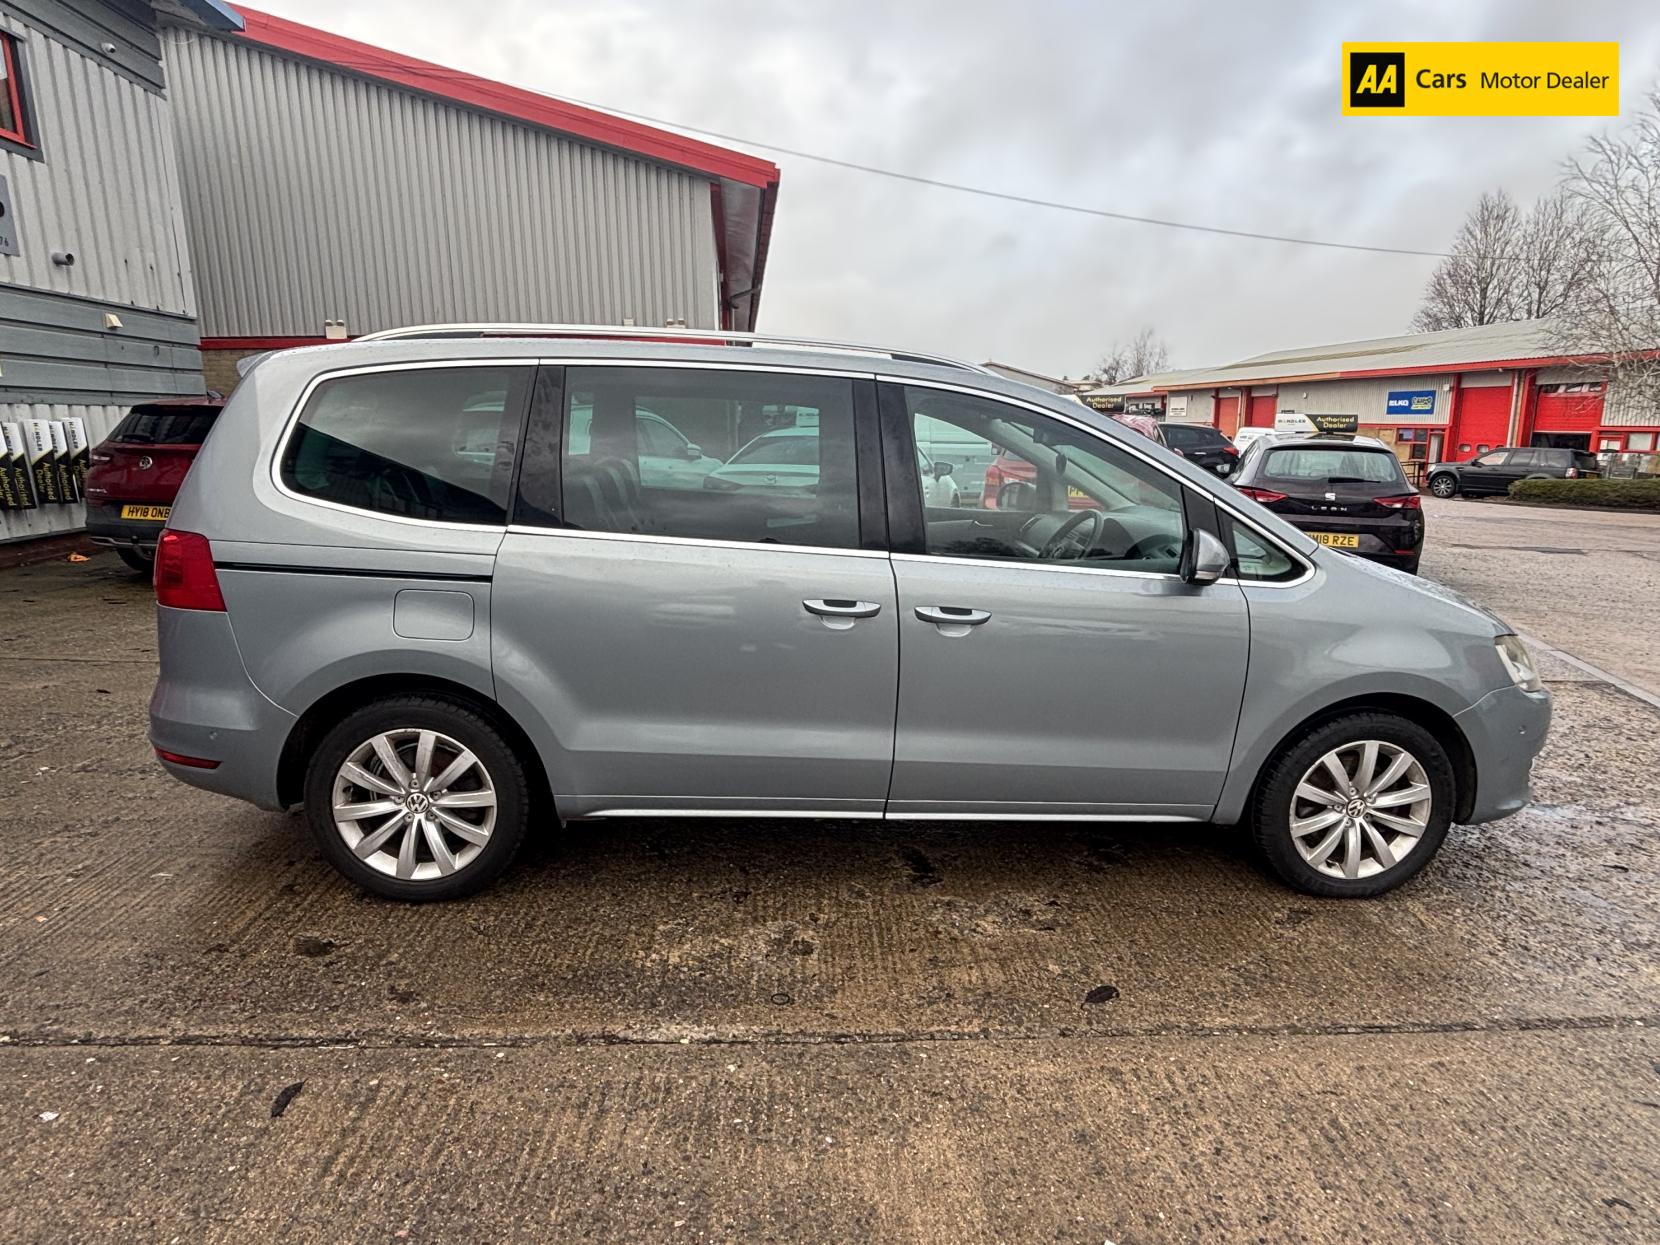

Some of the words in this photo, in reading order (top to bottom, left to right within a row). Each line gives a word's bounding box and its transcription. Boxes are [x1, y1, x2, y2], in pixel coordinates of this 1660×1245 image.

[0, 466, 18, 506] Authorised
[36, 469, 46, 493] Dealer
[43, 462, 57, 500] Authorised
[58, 463, 74, 500] Authorised
[127, 506, 149, 518] HY18
[1332, 535, 1355, 546] RZE
